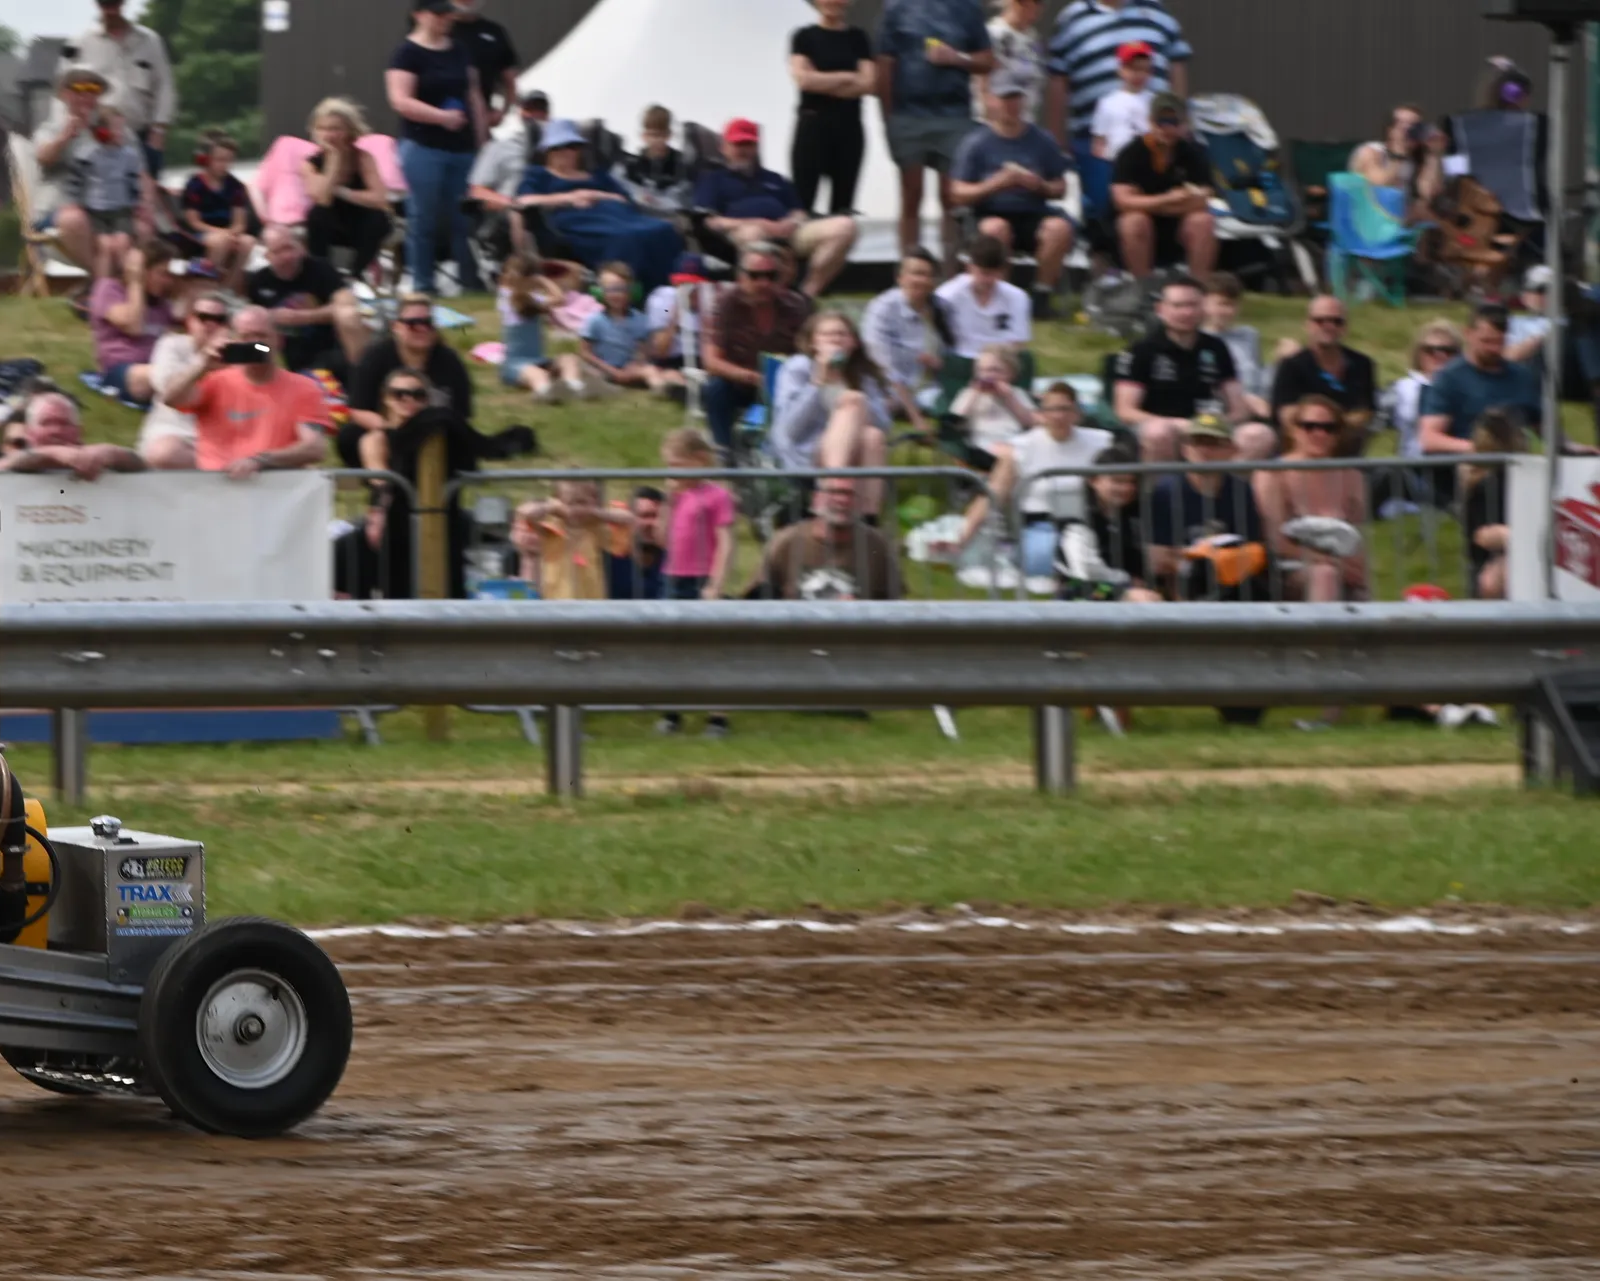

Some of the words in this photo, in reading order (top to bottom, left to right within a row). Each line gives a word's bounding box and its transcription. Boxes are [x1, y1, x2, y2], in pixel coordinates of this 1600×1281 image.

[16, 538, 154, 558] MACHINERY
[17, 564, 37, 583] &
[40, 561, 176, 587] EQUIPMENT
[117, 885, 173, 901] TRAX
